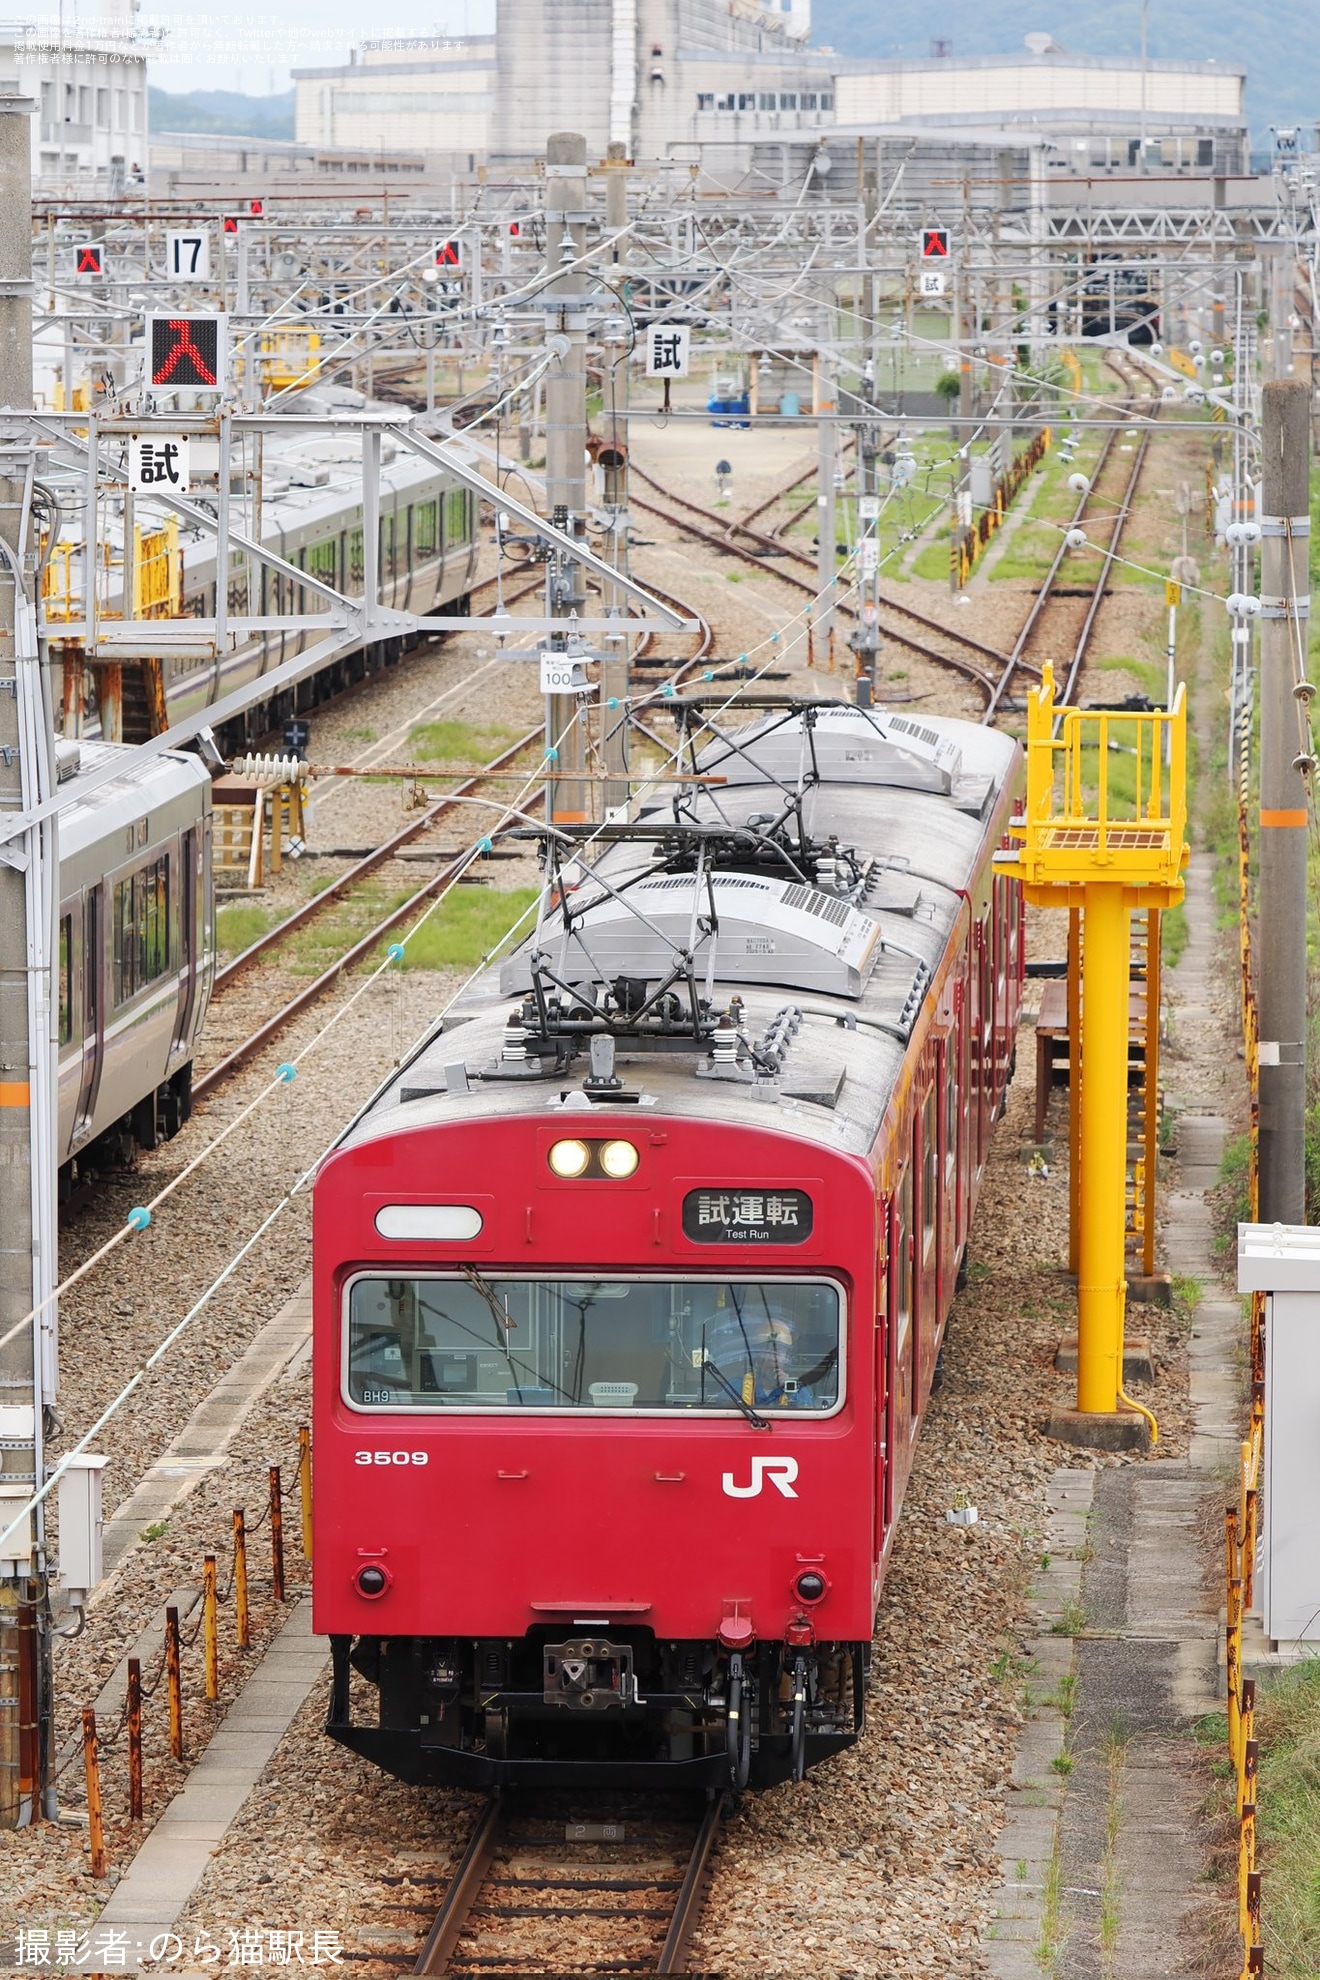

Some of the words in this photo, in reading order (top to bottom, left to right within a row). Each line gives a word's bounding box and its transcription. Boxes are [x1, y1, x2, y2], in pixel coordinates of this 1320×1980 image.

[174, 238, 202, 274] 17
[925, 276, 939, 292] 試
[153, 320, 217, 385] 入
[653, 333, 682, 370] 試
[140, 443, 180, 484] 試
[546, 673, 571, 685] 100
[698, 1195, 799, 1226] 試運転
[726, 1229, 747, 1239] Test
[749, 1229, 770, 1239] Run
[364, 1390, 389, 1402] BH9
[354, 1451, 429, 1465] 3509
[722, 1456, 799, 1498] JR
[575, 1825, 586, 1838] 2
